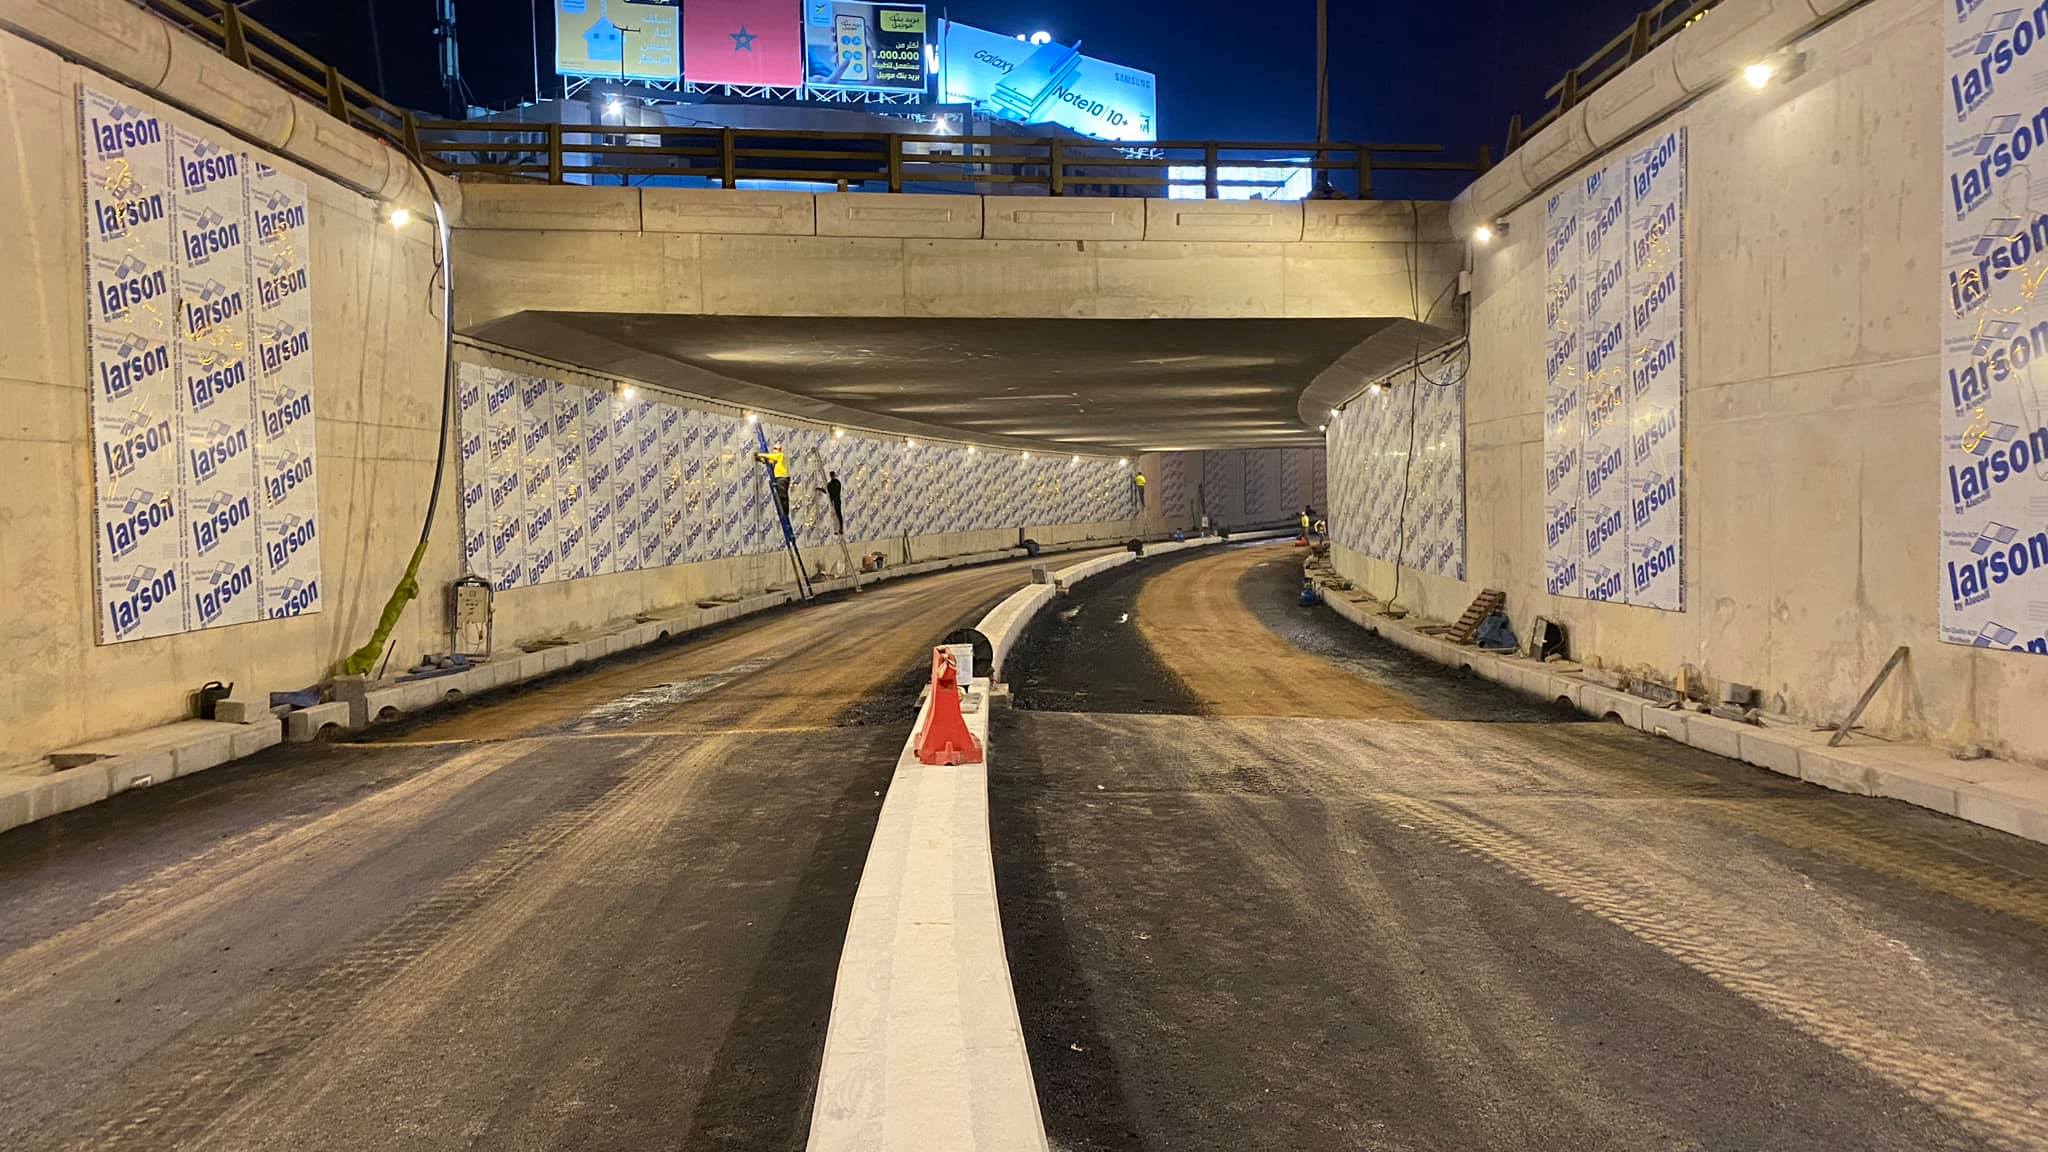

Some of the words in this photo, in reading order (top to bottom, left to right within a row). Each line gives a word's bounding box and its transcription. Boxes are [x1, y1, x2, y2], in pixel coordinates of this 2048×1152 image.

[871, 50, 919, 60] 1.000.000
[974, 50, 1015, 75] Galaxy
[1951, 1, 2048, 115] larson
[1114, 72, 1151, 89] SAMSUNG
[92, 117, 161, 153] larson
[180, 153, 238, 188] larson
[1633, 133, 1676, 200] larson
[1951, 106, 2048, 213] larson
[95, 194, 164, 234] larson
[255, 204, 305, 238] larson
[1586, 196, 1623, 254] larson
[1633, 202, 1676, 266] larson
[183, 222, 240, 261] larson
[1546, 214, 1577, 268] larson
[1949, 214, 2048, 310] larson
[98, 269, 167, 316] larson
[257, 267, 307, 305] larson
[1546, 273, 1577, 325] larson
[1586, 258, 1622, 315] larson
[1633, 271, 1676, 331] larson
[186, 291, 243, 334] larson
[259, 331, 309, 371] larson
[1546, 331, 1577, 380] larson
[1586, 321, 1622, 373] larson
[1633, 339, 1676, 395] larson
[1949, 321, 2048, 408] larson
[100, 345, 169, 395] larson
[188, 360, 246, 407] larson
[487, 381, 515, 412] larson
[522, 379, 548, 407] larson
[1546, 389, 1577, 431] larson
[1586, 384, 1622, 435] larson
[262, 393, 311, 438] larson
[524, 421, 549, 452] larson
[555, 403, 579, 434] larson
[1633, 407, 1676, 460] larson
[104, 420, 172, 475] larson
[190, 427, 248, 479] larson
[557, 444, 580, 474] larson
[586, 426, 608, 453] larson
[615, 445, 635, 472] larson
[639, 429, 657, 455] larson
[264, 456, 313, 501] larson
[526, 464, 551, 496] larson
[588, 464, 609, 493] larson
[1546, 447, 1577, 490] larson
[1586, 448, 1622, 494] larson
[1949, 427, 2048, 505] larson
[491, 473, 518, 507] larson
[616, 482, 636, 508] larson
[1632, 476, 1676, 524] larson
[107, 498, 174, 555] larson
[193, 496, 251, 551] larson
[493, 518, 520, 554] larson
[527, 508, 552, 541] larson
[589, 502, 611, 533] larson
[617, 519, 637, 547] larson
[1546, 508, 1577, 545] larson
[1586, 509, 1622, 552] larson
[266, 518, 315, 569] larson
[560, 526, 584, 558] larson
[591, 541, 612, 572] larson
[529, 550, 554, 585] larson
[1546, 562, 1577, 595] larson
[1632, 544, 1676, 588] larson
[1948, 532, 2048, 601] larson
[110, 568, 177, 634] larson
[196, 564, 252, 622] larson
